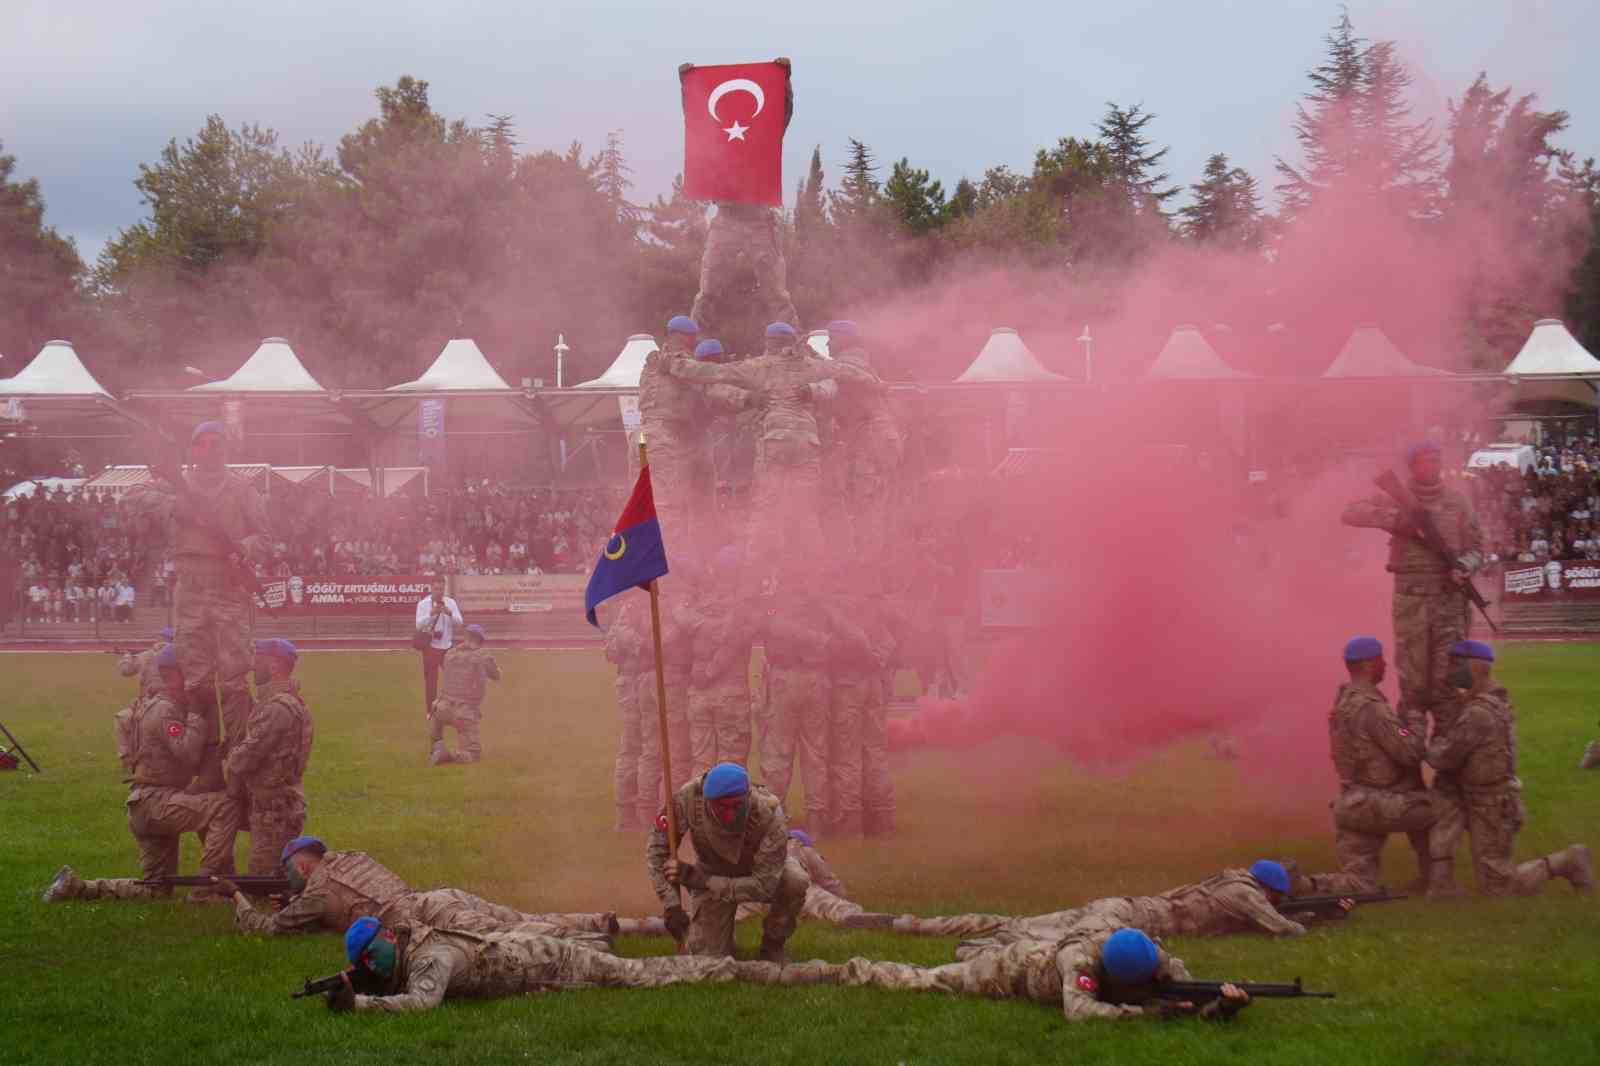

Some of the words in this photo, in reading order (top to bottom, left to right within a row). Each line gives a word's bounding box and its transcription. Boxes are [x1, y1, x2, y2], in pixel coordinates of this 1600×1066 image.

[306, 582, 344, 593] SÖĞÜT
[344, 582, 396, 593] ERTUĞRUL
[311, 594, 345, 603] ANMA
